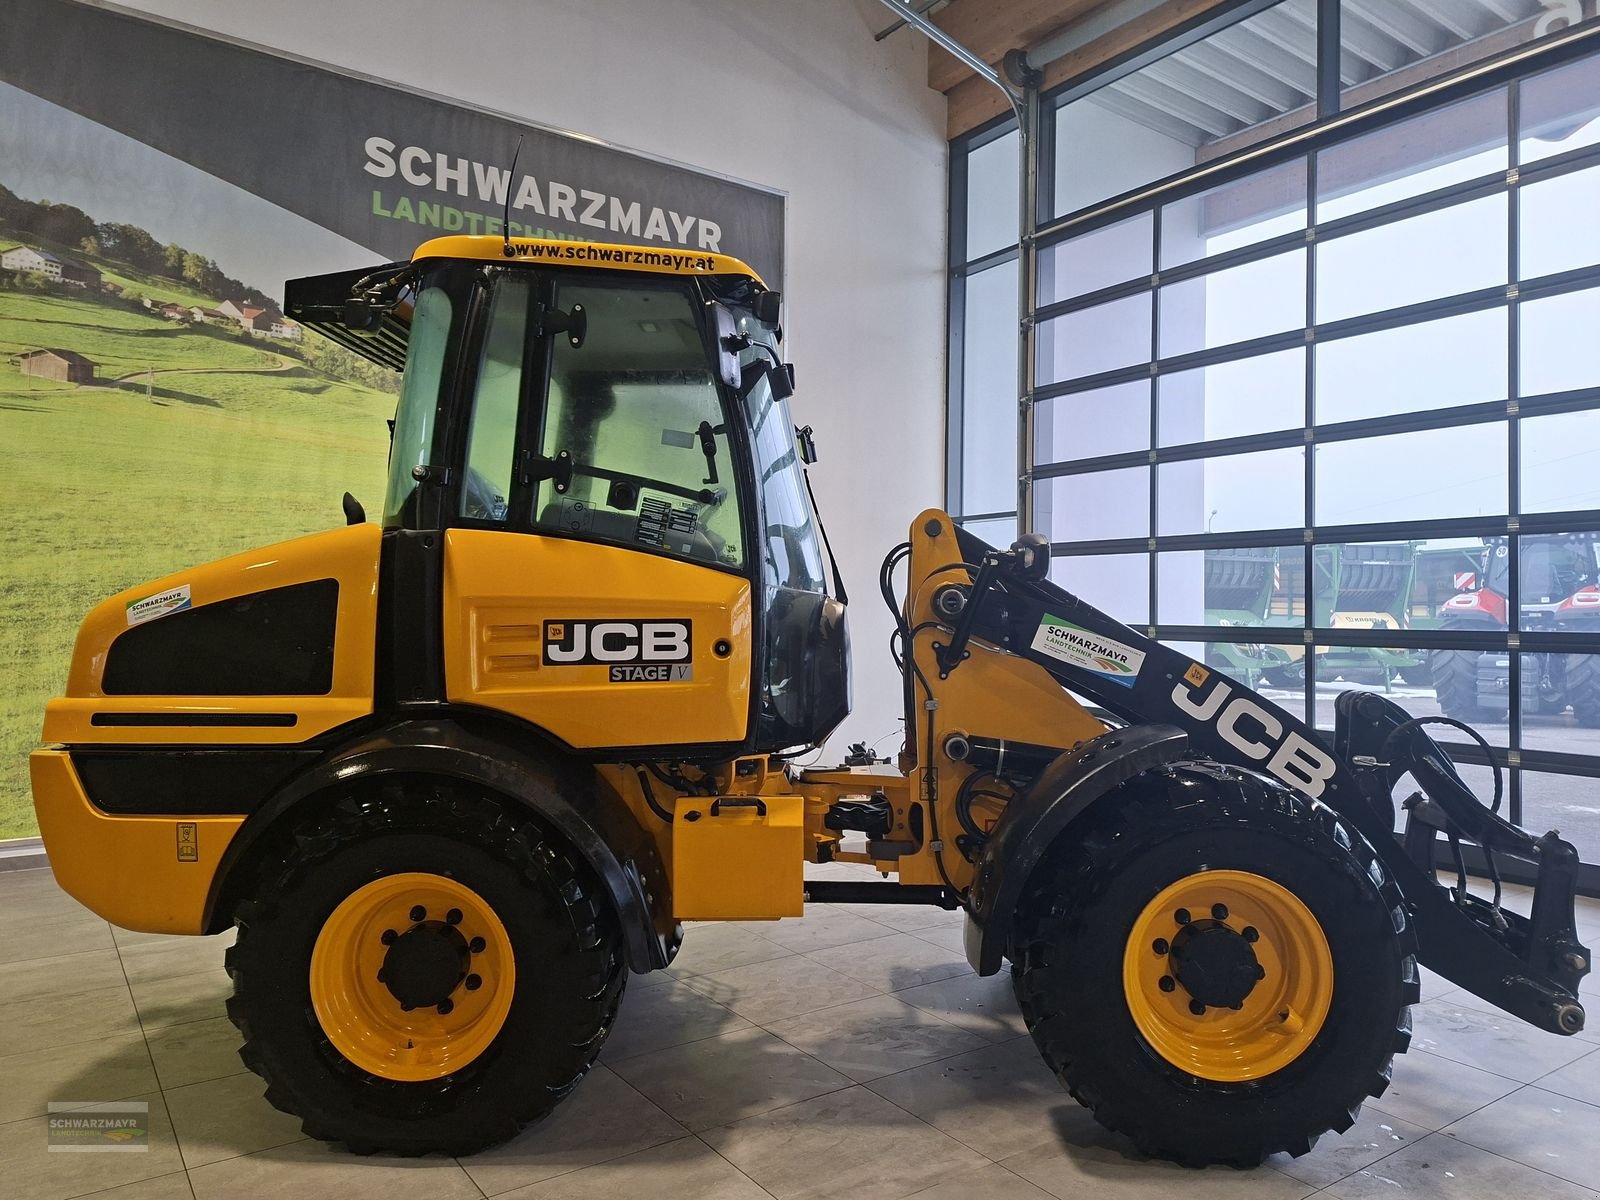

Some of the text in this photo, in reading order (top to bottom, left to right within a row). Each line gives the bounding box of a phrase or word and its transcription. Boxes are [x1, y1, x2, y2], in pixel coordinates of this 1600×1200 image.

[363, 136, 722, 253] SCHWARZMAYR
[515, 242, 715, 272] www.schwarzmayr.at
[132, 592, 181, 611] SCHWARZMAYR
[547, 623, 689, 661] JCB
[1046, 635, 1093, 659] LANDTECHNIK
[1047, 626, 1129, 663] SCHWARZMAYR
[611, 665, 688, 681] STAGE V
[1171, 680, 1337, 799] JCB
